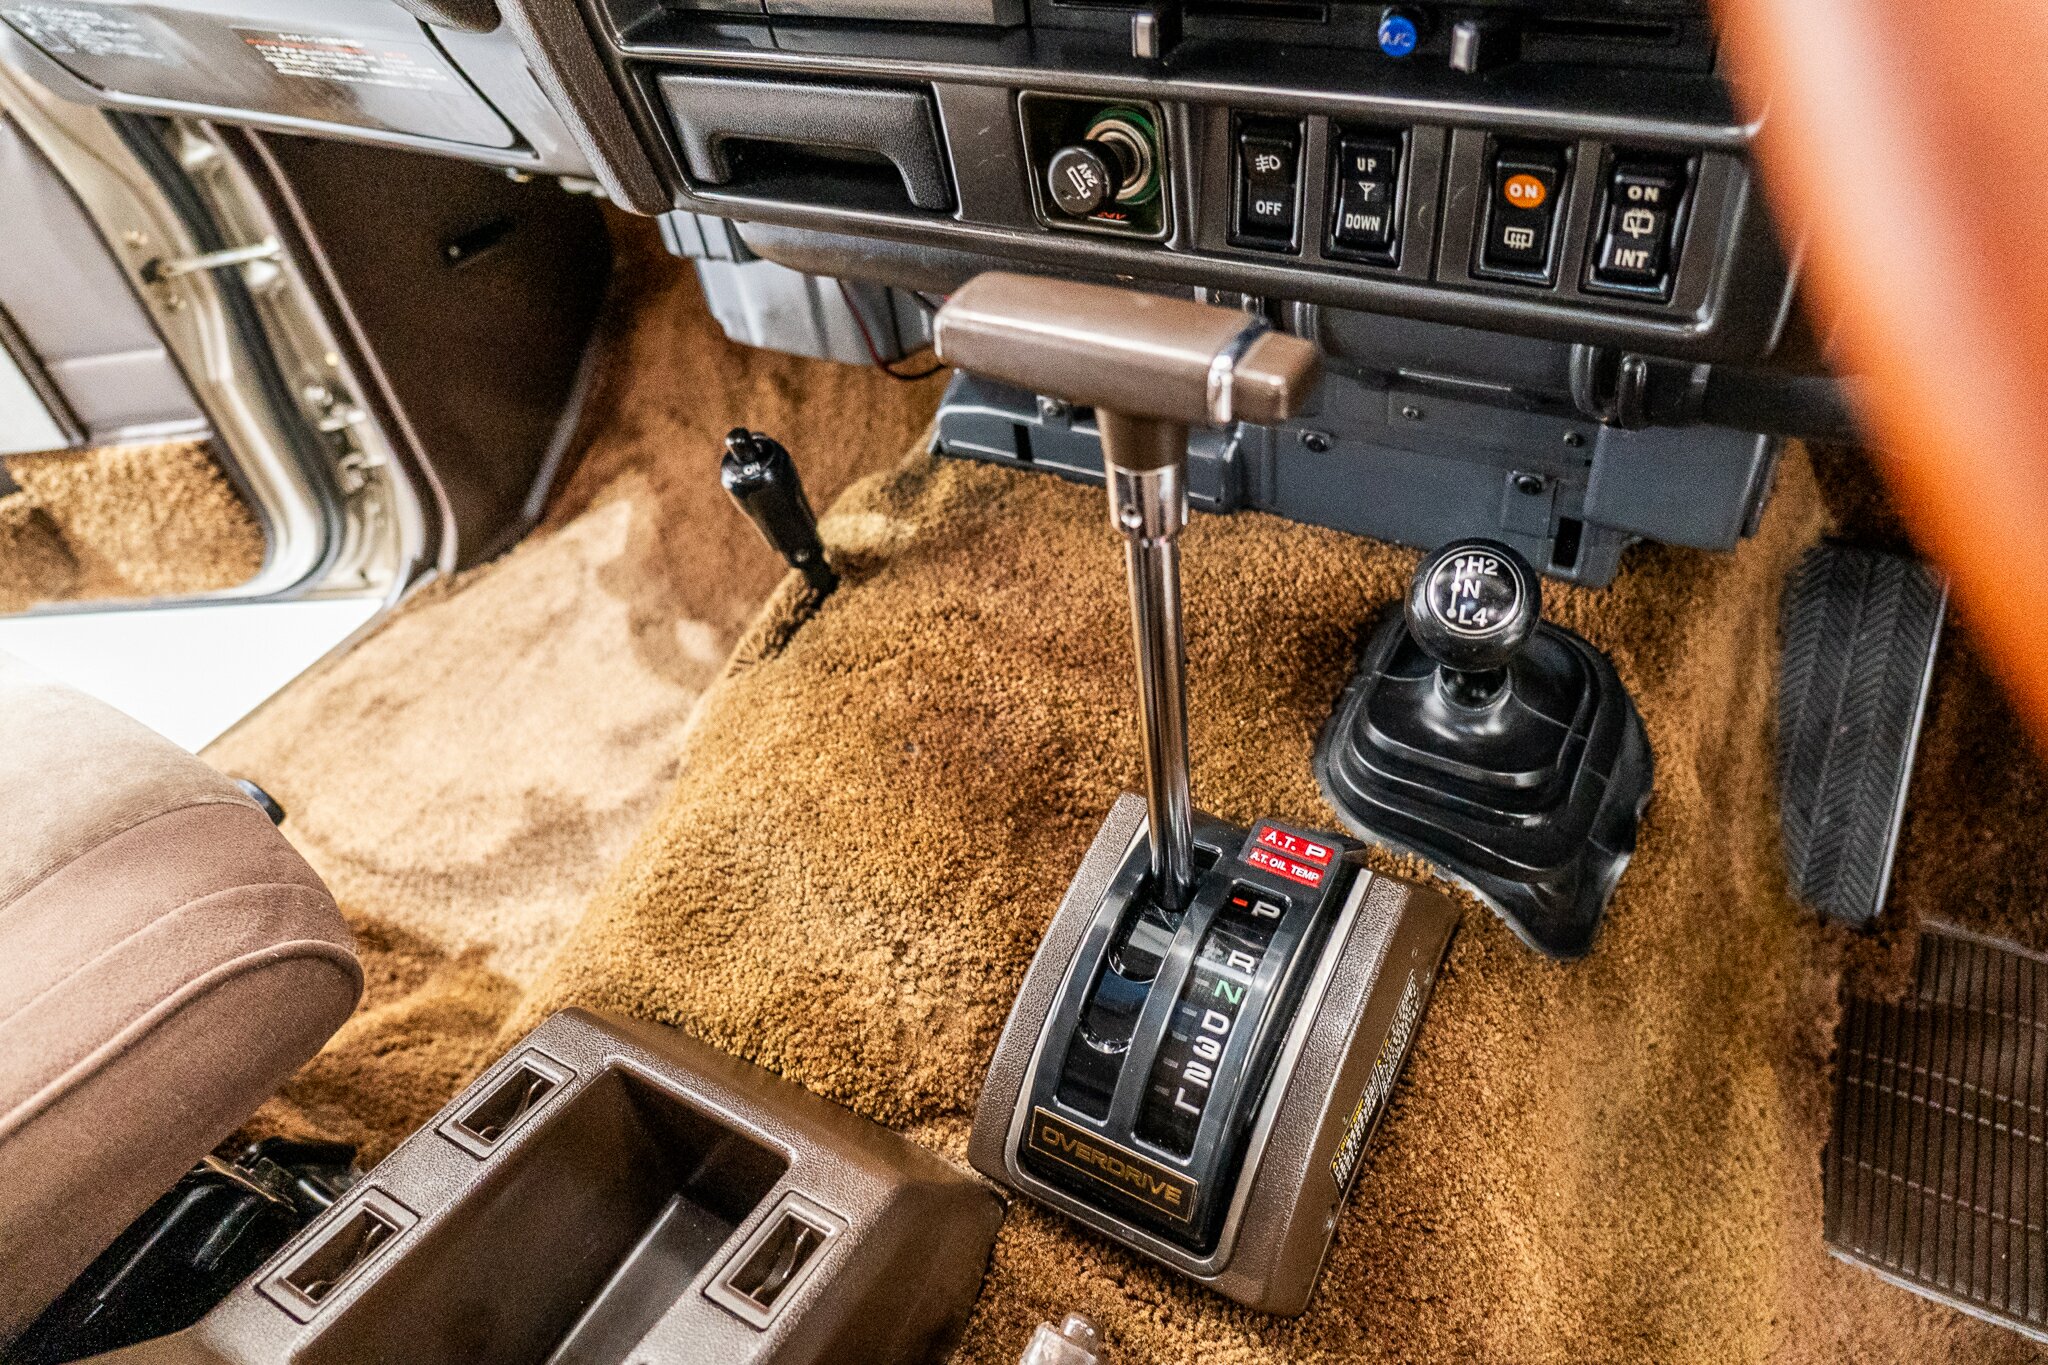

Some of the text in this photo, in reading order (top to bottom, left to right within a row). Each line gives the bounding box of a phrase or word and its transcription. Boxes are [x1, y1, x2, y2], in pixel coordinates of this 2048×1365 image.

[1077, 163, 1099, 187] 24V
[1356, 157, 1376, 173] UP
[1509, 183, 1538, 199] ON
[1627, 185, 1659, 202] ON
[1255, 201, 1282, 216] OFF
[1345, 213, 1380, 231] DOWN
[1614, 248, 1649, 268] INT
[1466, 556, 1499, 576] H2
[1462, 579, 1482, 599] N
[1458, 604, 1488, 627] L4
[1264, 830, 1327, 858] A.T. P
[1250, 851, 1320, 881] A.T. OIL TEMP
[1251, 900, 1281, 919] P
[1227, 950, 1255, 974] R
[1214, 979, 1244, 1005] N
[1201, 1008, 1230, 1036] D
[1192, 1035, 1222, 1062] 3
[1182, 1060, 1212, 1088] 2
[1174, 1087, 1200, 1115] L
[1041, 1126, 1182, 1206] OVERDRIVE
